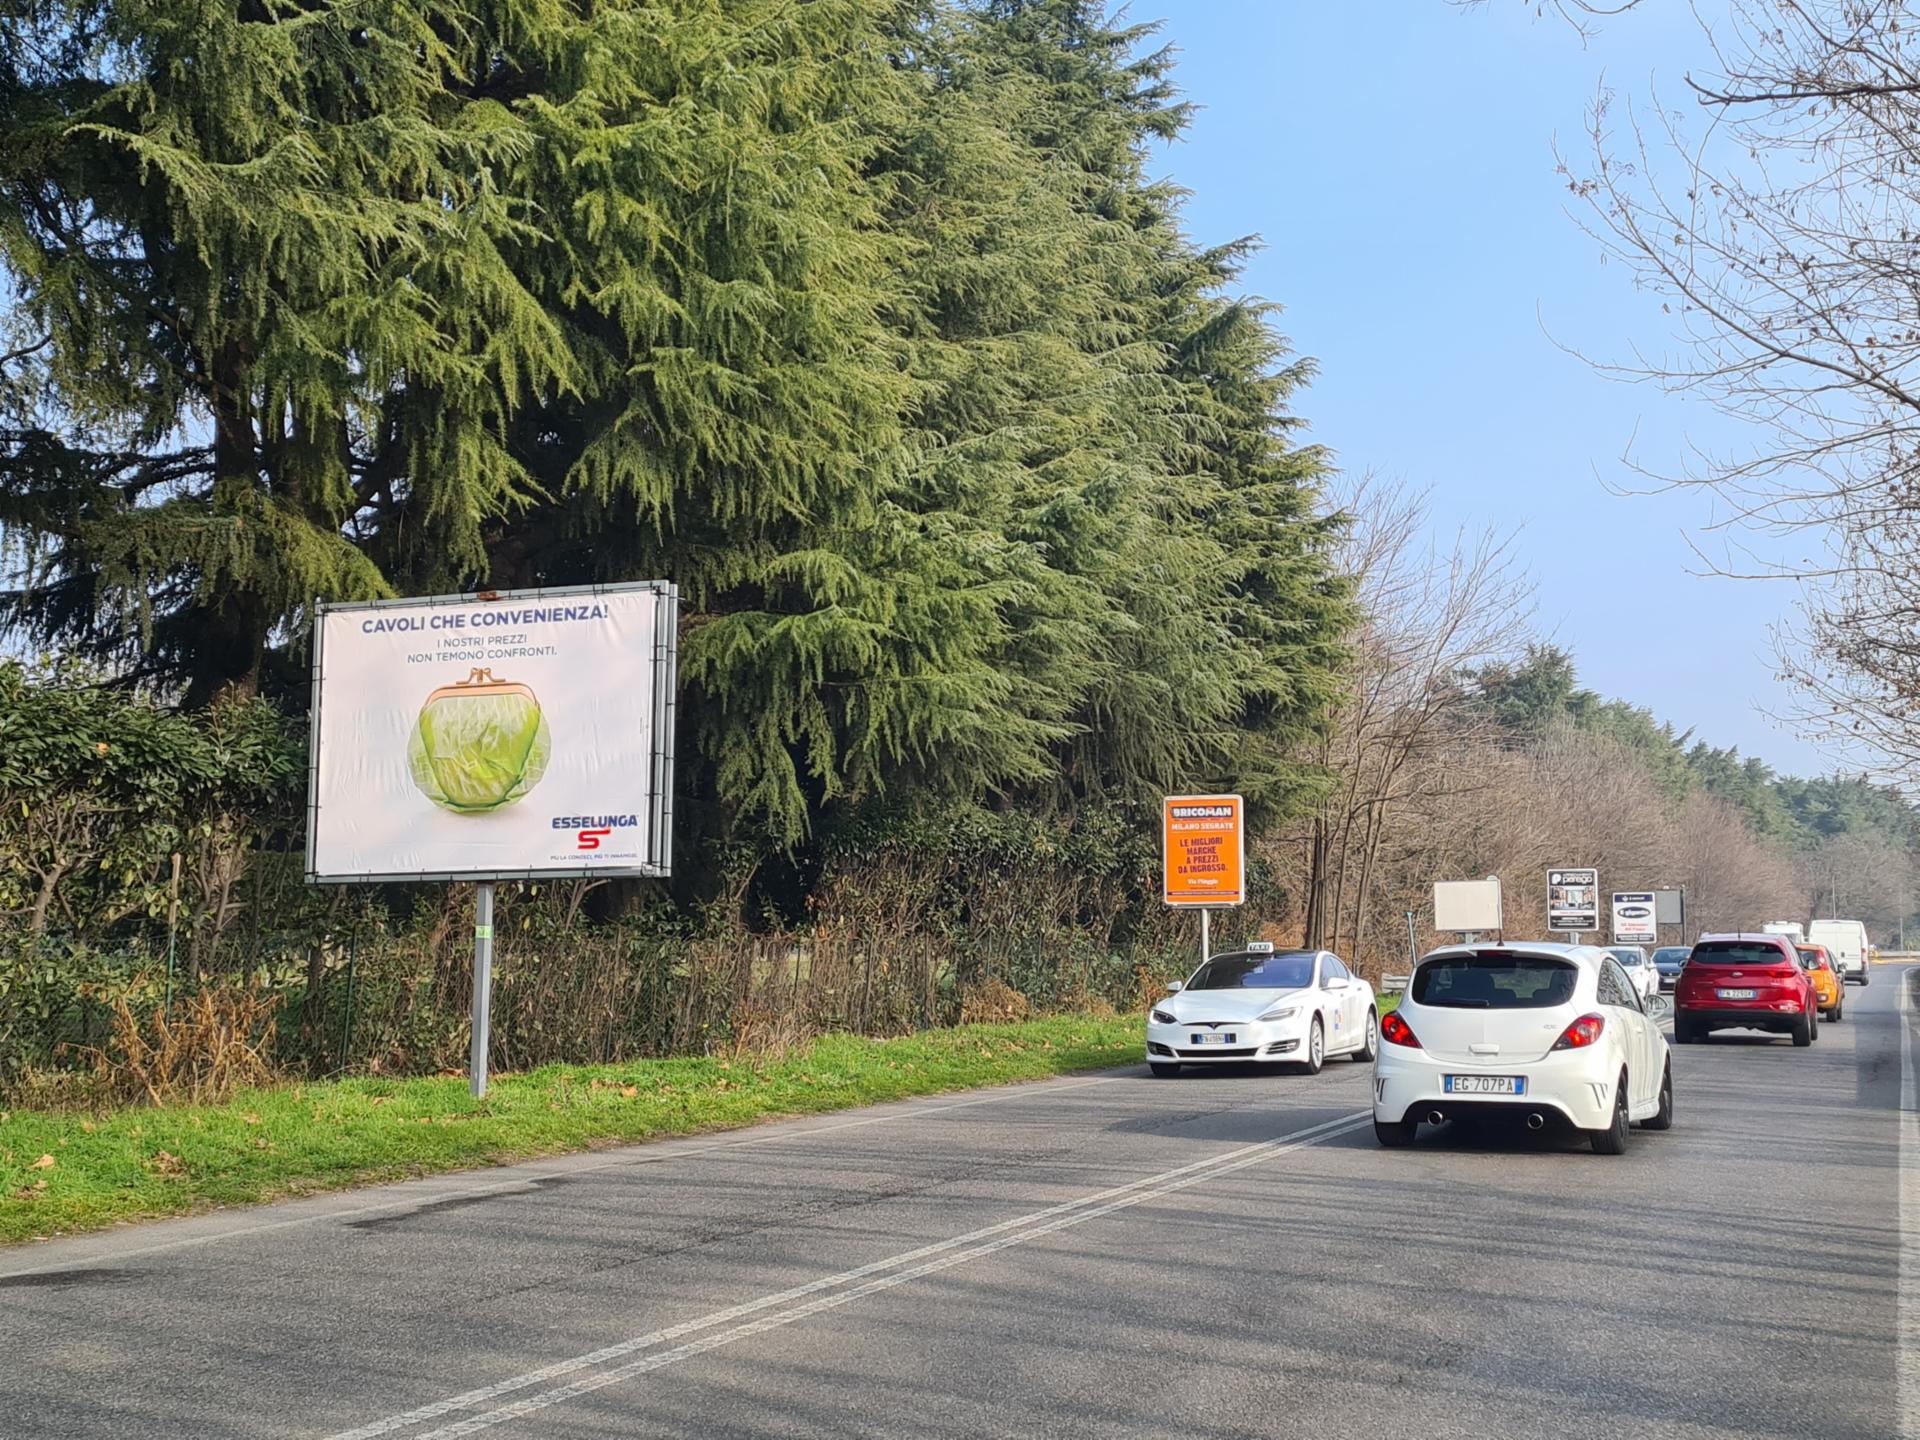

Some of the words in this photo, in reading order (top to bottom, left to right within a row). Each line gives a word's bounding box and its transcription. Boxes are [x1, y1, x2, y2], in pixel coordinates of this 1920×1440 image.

[361, 616, 425, 634] CAVOLI
[430, 614, 466, 630] CHE
[470, 604, 609, 628] CONVENIENZA!
[443, 637, 484, 648] NOSTRI
[488, 634, 527, 646] PREZZI
[407, 653, 432, 663] NON
[434, 651, 484, 662] TEMONO
[487, 646, 558, 659] CONFRONTI.
[1173, 806, 1232, 817] BRICOMAN
[551, 815, 638, 829] ESSELUNGA
[1186, 846, 1217, 855] MARCHE
[1193, 855, 1219, 864] PREZZI
[1454, 1077, 1469, 1091] EG
[1473, 1078, 1513, 1092] 707PA
